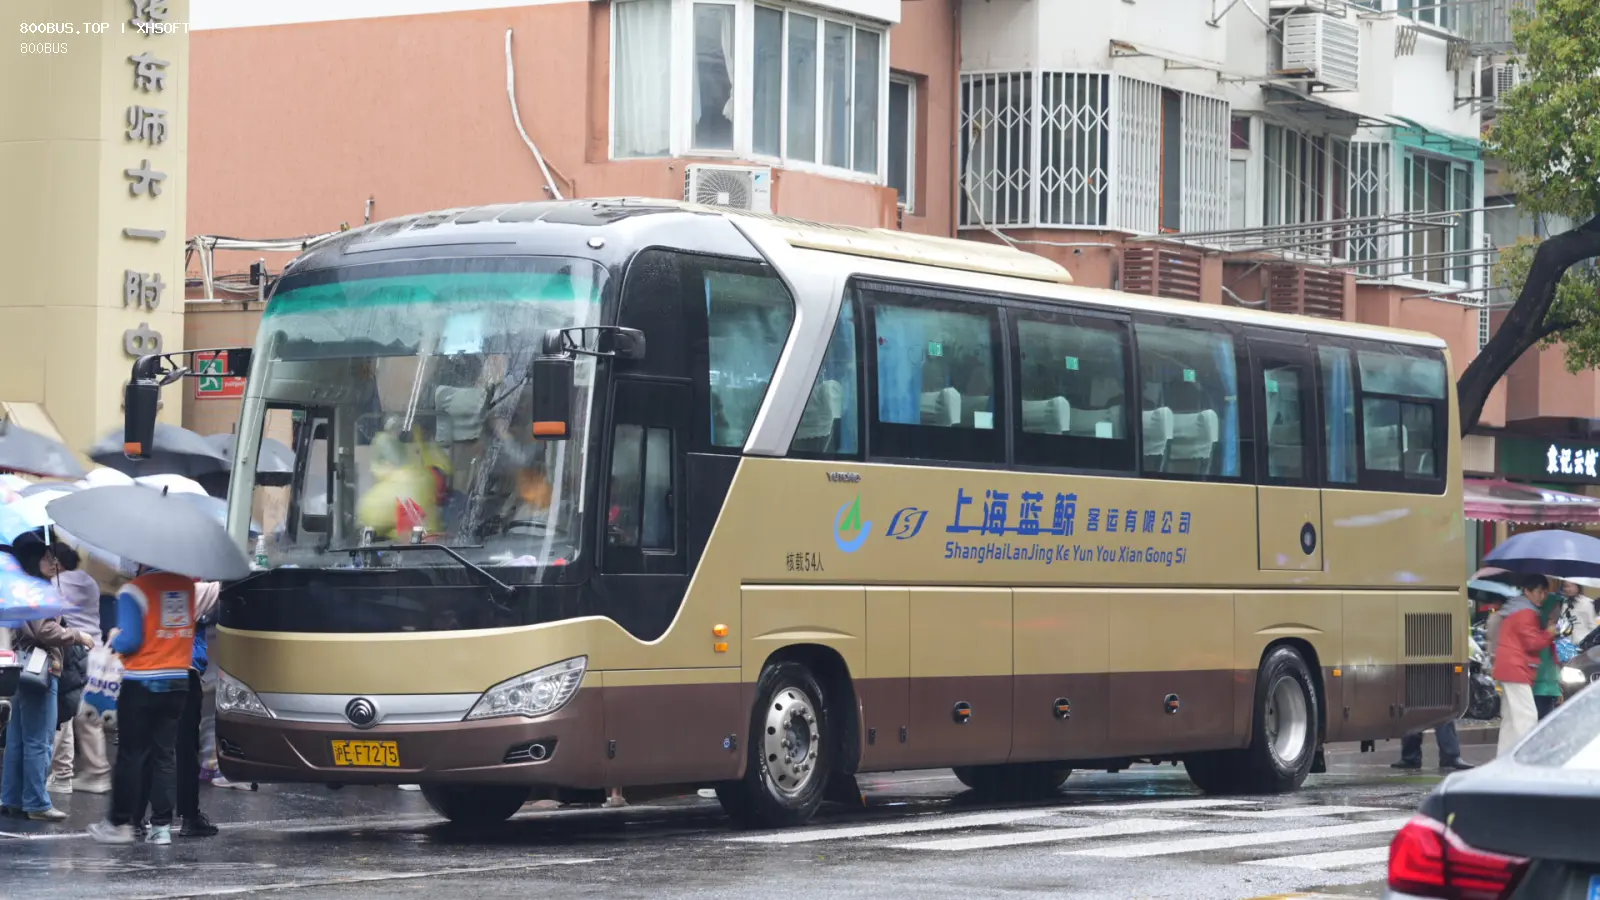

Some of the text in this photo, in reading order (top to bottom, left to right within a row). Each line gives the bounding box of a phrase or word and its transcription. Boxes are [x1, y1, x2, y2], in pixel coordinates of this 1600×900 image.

[786, 551, 825, 572] 核载54人
[945, 541, 1187, 567] ShangHaiLanJing Ke Yun You Xian Gong Si
